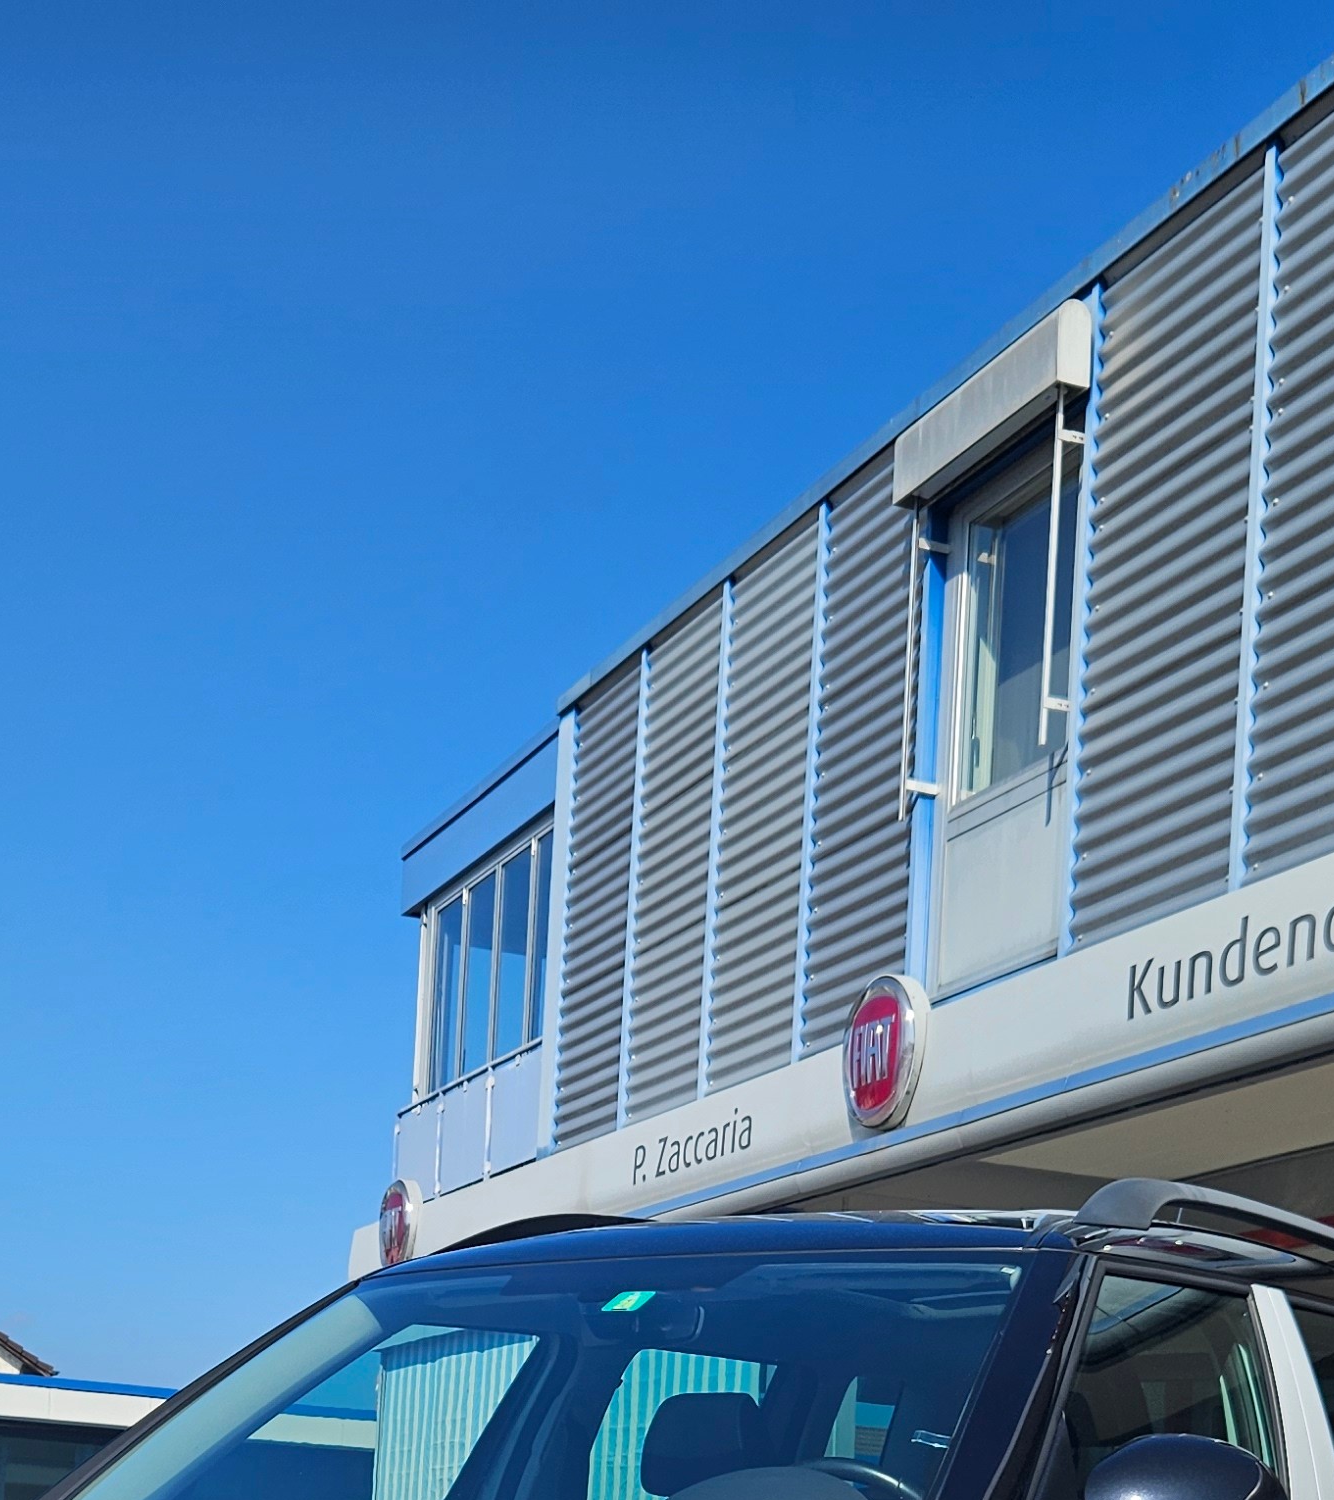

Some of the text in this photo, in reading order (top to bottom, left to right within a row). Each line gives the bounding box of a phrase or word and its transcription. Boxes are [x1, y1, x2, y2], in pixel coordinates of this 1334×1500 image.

[853, 1013, 896, 1089] FIAT
[633, 1107, 752, 1186] P. Zaccaria
